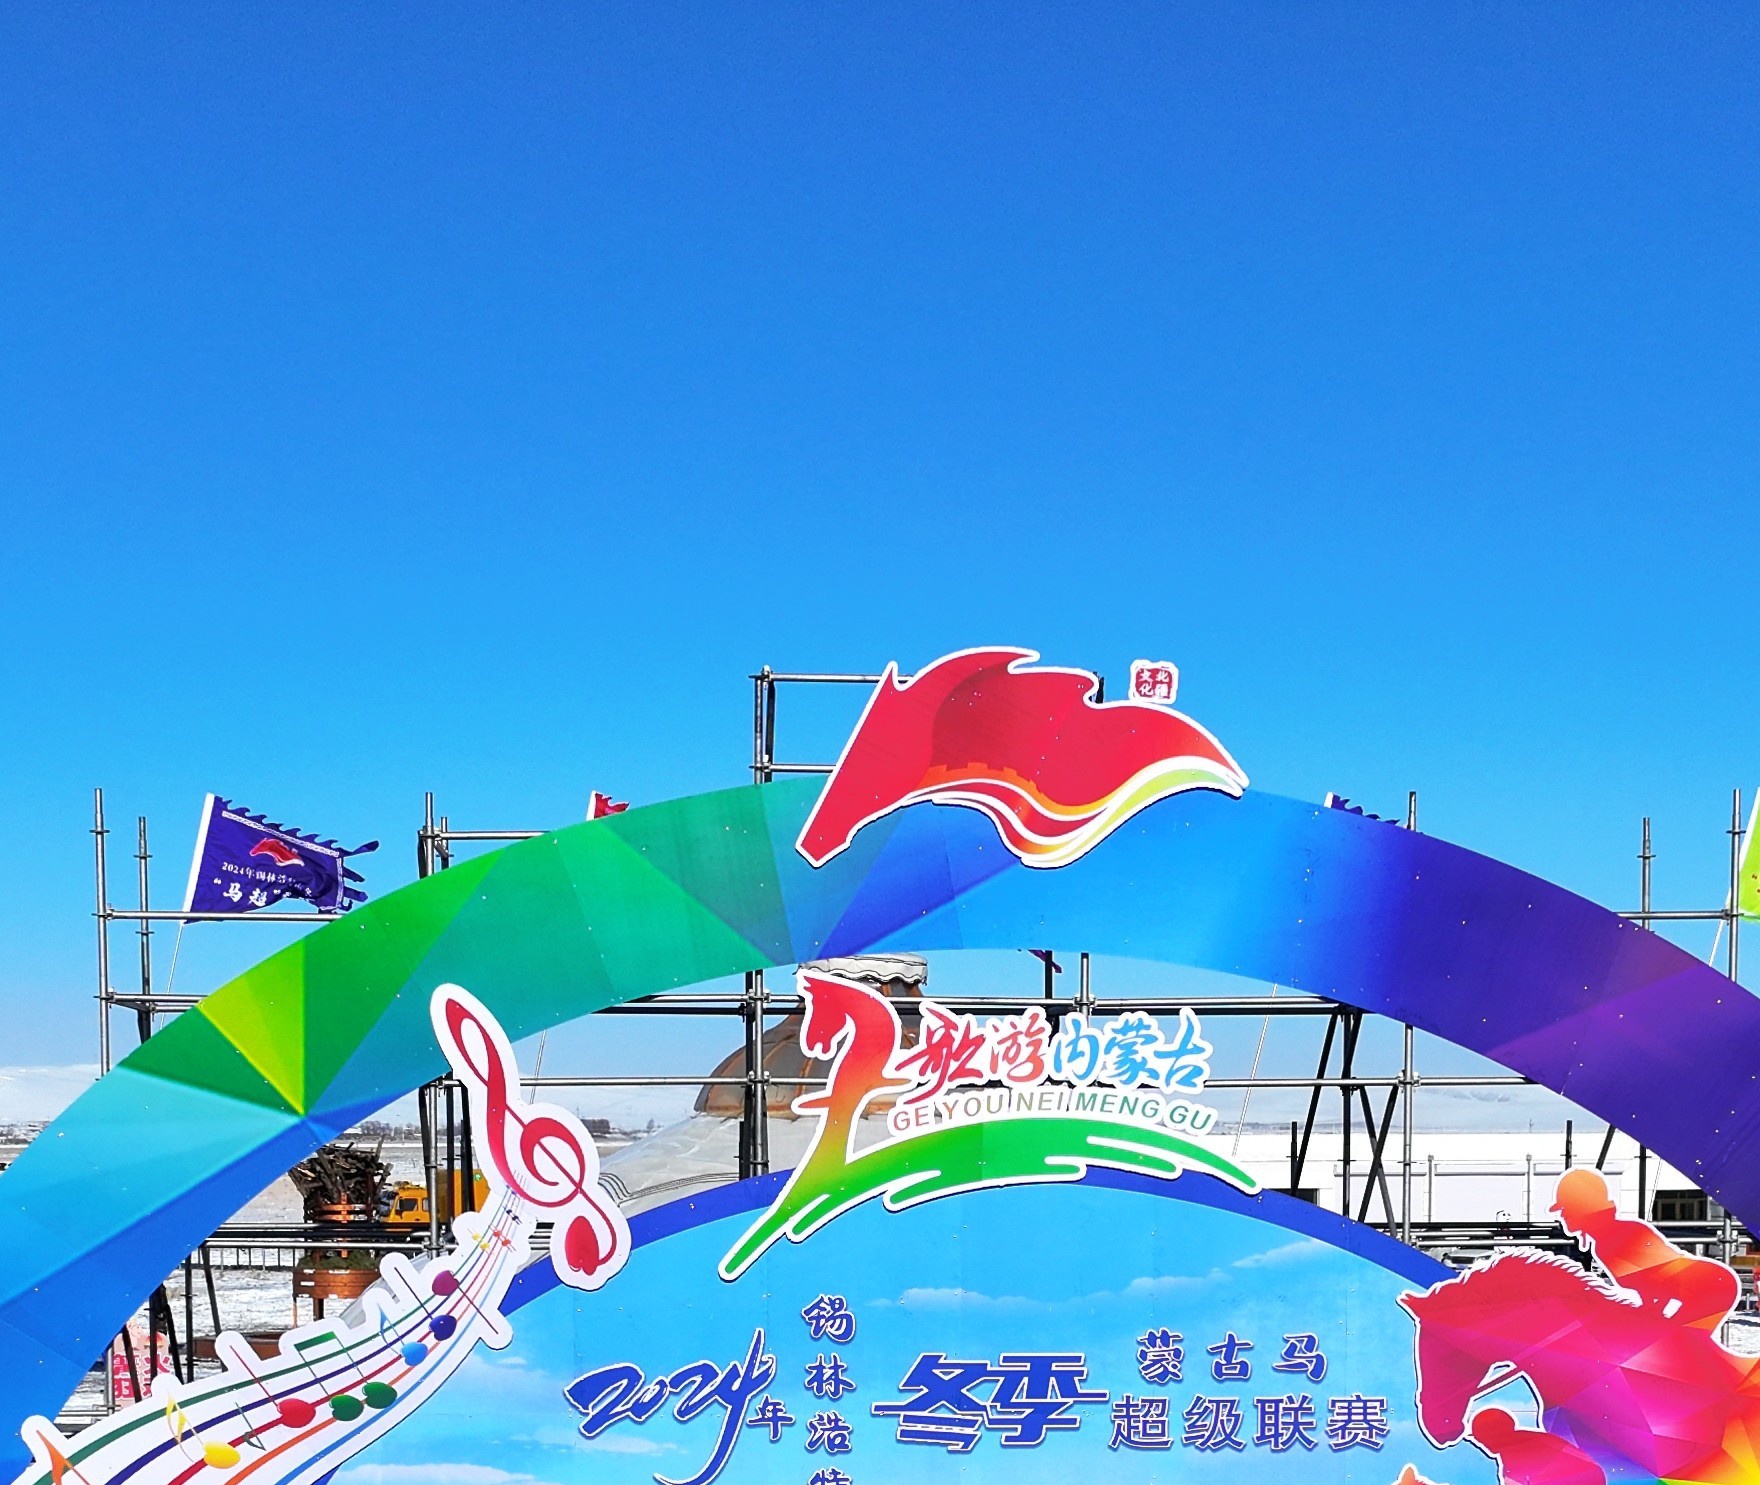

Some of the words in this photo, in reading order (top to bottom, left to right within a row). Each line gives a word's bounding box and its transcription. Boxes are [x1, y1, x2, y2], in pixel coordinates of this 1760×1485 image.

[895, 1007, 1207, 1105] 歌游内蒙古
[893, 1106, 930, 1131] GE
[943, 1095, 1003, 1120] YOU
[1016, 1091, 1062, 1112] NEI
[1077, 1092, 1159, 1119] MENG
[1169, 1105, 1215, 1131] GU
[1136, 1329, 1328, 1383] 蒙古马
[871, 1353, 1110, 1454] 冬季
[1108, 1394, 1391, 1453] 超级联赛
